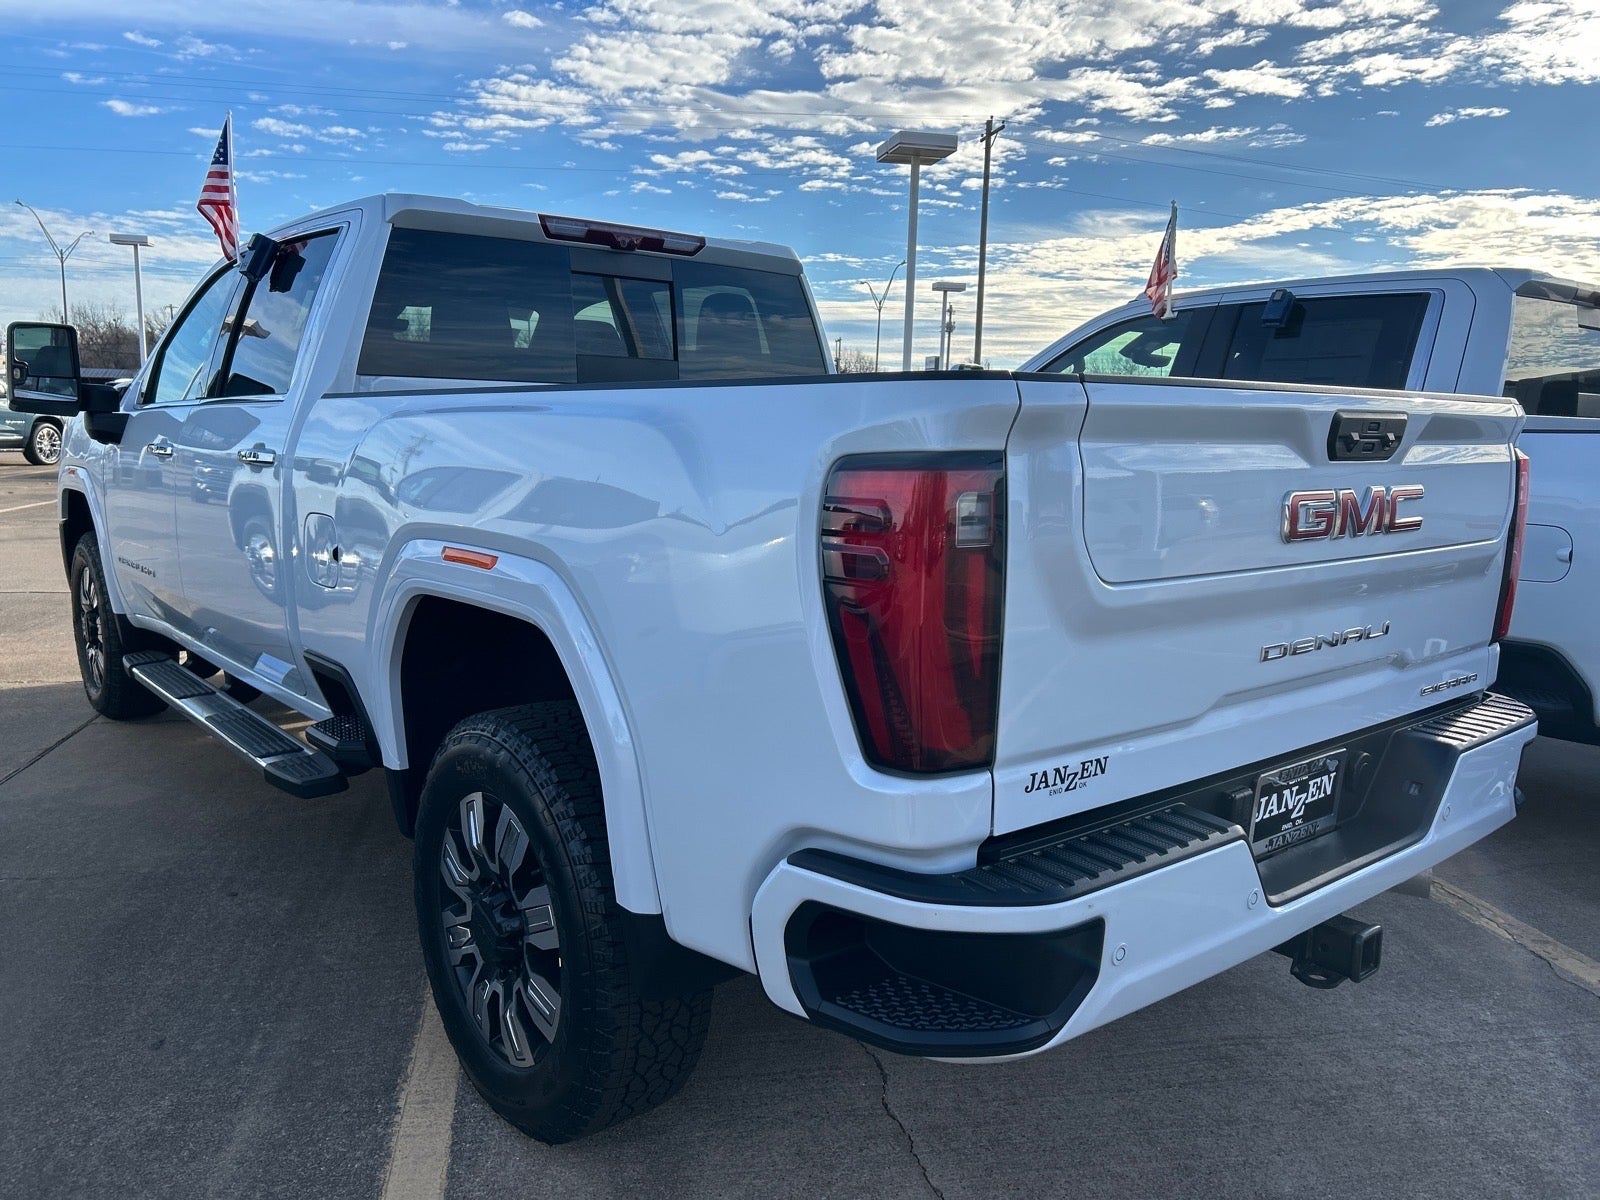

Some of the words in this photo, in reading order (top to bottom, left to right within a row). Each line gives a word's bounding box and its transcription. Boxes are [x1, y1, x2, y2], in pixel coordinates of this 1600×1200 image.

[1280, 484, 1424, 544] GMC
[1260, 620, 1390, 662] DENALI
[1420, 672, 1478, 696] SIERRA
[1024, 756, 1109, 793] JANZEN
[1049, 787, 1063, 796] ENID
[1078, 781, 1087, 789] OK
[1254, 772, 1337, 823] JANZEN
